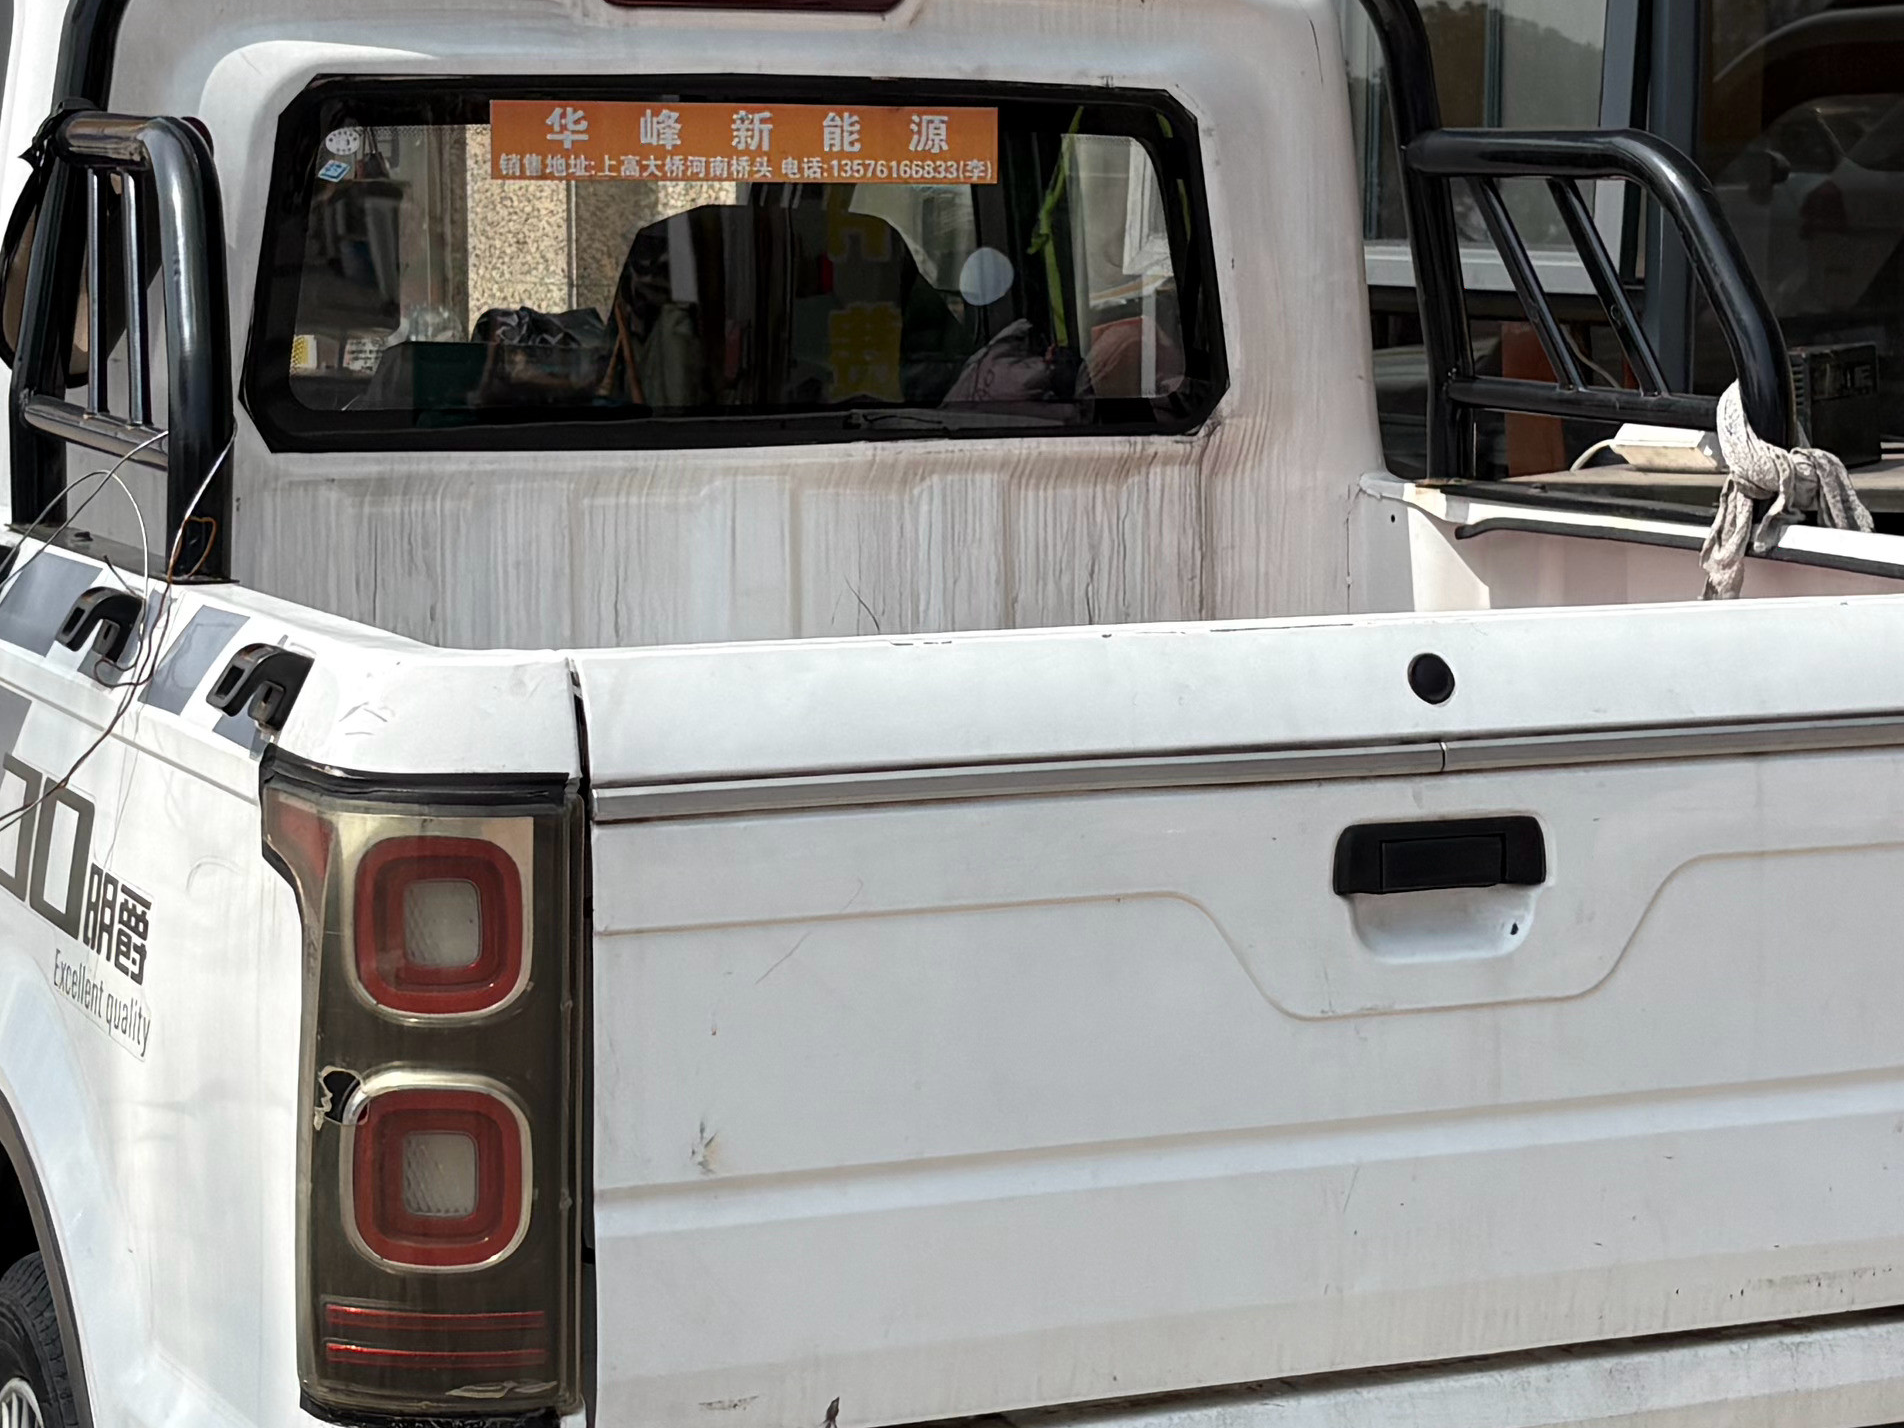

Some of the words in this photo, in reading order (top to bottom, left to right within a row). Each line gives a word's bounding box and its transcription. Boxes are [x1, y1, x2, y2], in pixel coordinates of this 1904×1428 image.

[544, 106, 950, 154] 华峰新能源
[499, 152, 774, 179] 销售地址:上高大桥河南桥头
[781, 155, 994, 182] 电话:13576166833(李)
[53, 947, 105, 1020] Excellent
[105, 991, 152, 1059] quality
